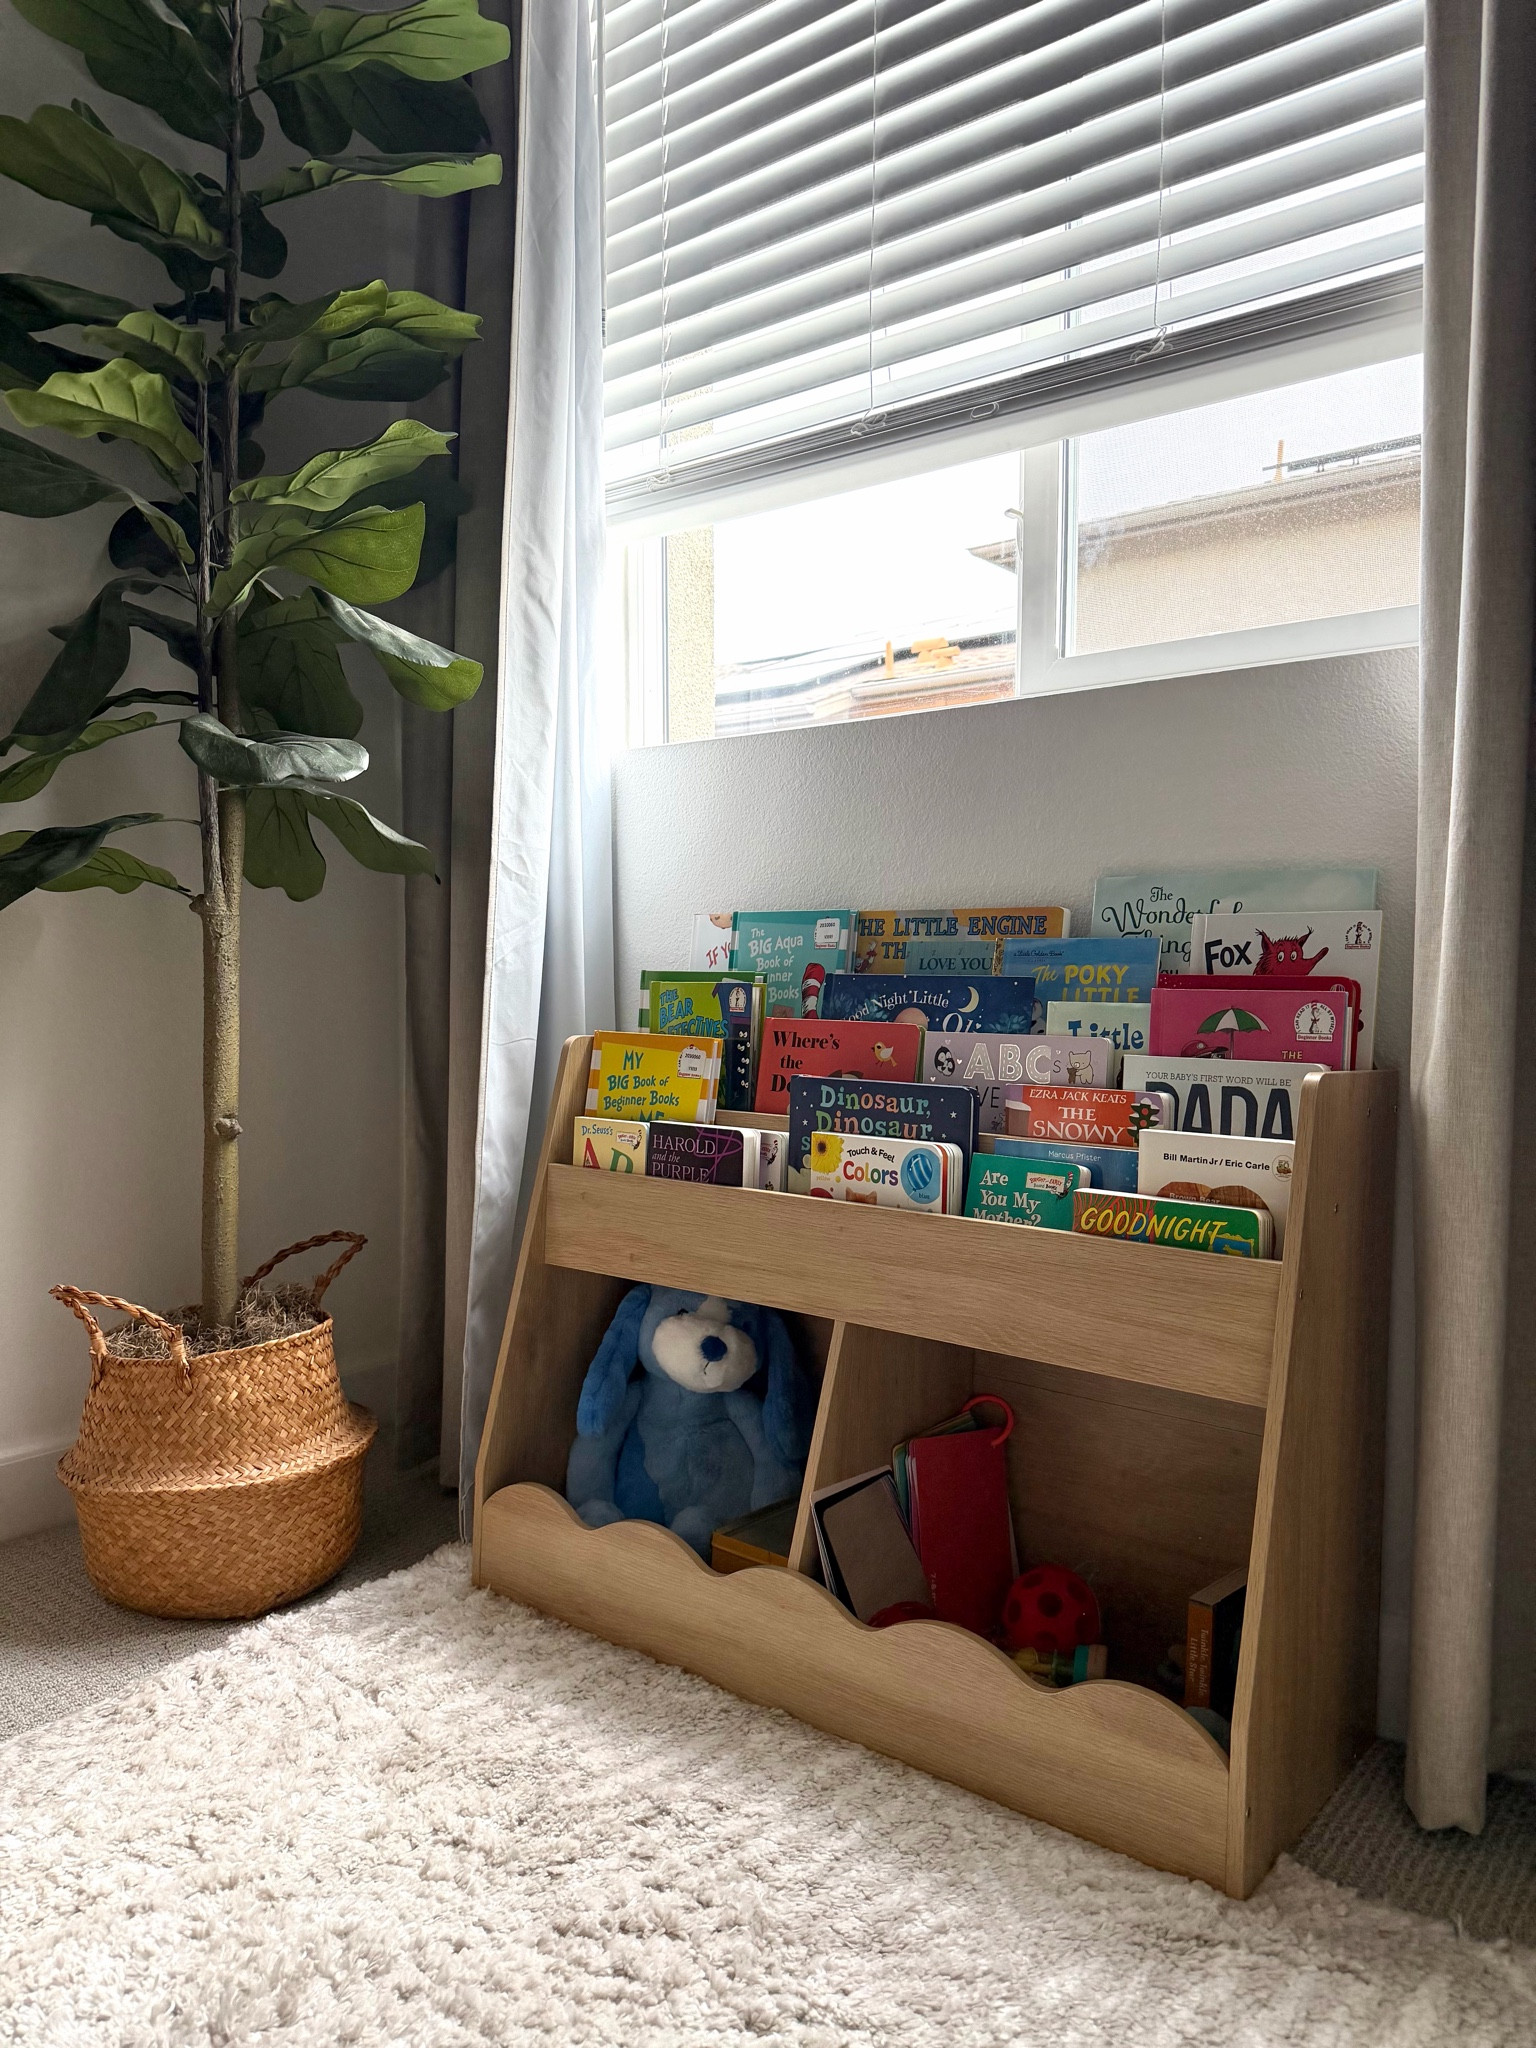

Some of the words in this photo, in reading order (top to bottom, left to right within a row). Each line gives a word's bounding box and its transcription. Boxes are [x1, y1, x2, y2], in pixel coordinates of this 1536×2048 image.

[1150, 886, 1173, 902] The
[751, 927, 765, 938] The
[858, 918, 885, 937] HE
[893, 916, 958, 937] LITTLE
[967, 915, 1048, 936] ENGINE
[749, 939, 773, 958] BIG
[775, 935, 803, 955] Aqua
[706, 946, 719, 968] IF
[756, 957, 781, 972] Book
[784, 955, 795, 968] of
[919, 957, 956, 971] LOVE
[959, 956, 994, 971] YOU
[1032, 963, 1059, 984] The
[1065, 964, 1130, 985] POKY
[659, 989, 679, 1006] THE
[768, 984, 800, 1004] Books
[871, 991, 907, 1010] Night
[911, 990, 950, 1008] Little
[659, 999, 693, 1029] BEAR
[659, 1016, 729, 1039] ETECTIVES
[772, 1031, 841, 1050] Where's
[622, 1050, 644, 1071] MY
[780, 1055, 804, 1070] the
[1281, 1050, 1303, 1060] THE
[607, 1074, 629, 1092] BIG
[632, 1075, 656, 1090] Book
[659, 1076, 670, 1087] of
[1146, 1071, 1169, 1080] YOUR
[1170, 1073, 1199, 1083] BABY'S
[1200, 1074, 1224, 1083] FIRST
[1225, 1075, 1254, 1085] WORD
[1255, 1077, 1278, 1086] WILL
[1279, 1079, 1292, 1087] BE
[603, 1095, 647, 1112] Beginner
[649, 1089, 680, 1106] Books
[820, 1084, 932, 1118] Dinosaur,
[1029, 1088, 1058, 1099] EZRA
[1060, 1090, 1089, 1102] JACK
[1092, 1092, 1128, 1104] KEATS
[1057, 1106, 1097, 1121] THE
[581, 1125, 592, 1136] Dr.
[592, 1123, 613, 1136] Seuss's
[1032, 1120, 1125, 1144] SNOWY
[652, 1134, 717, 1155] HAROLD
[651, 1150, 670, 1161] and
[672, 1151, 681, 1163] the
[846, 1146, 871, 1158] Touch
[871, 1146, 879, 1155] &
[878, 1149, 896, 1163] Feel
[1048, 1150, 1075, 1160] Marcus
[1076, 1151, 1102, 1162] Pfister
[1163, 1153, 1178, 1162] Bill
[1179, 1154, 1208, 1165] Martin
[1209, 1157, 1219, 1167] Jr
[1225, 1159, 1244, 1168] Eric
[1245, 1161, 1271, 1171] Carle
[652, 1161, 711, 1183] PURPLE
[842, 1160, 899, 1187] Colors
[979, 1169, 1009, 1186] Are
[979, 1189, 1009, 1207] You
[1012, 1191, 1041, 1215] My
[1080, 1206, 1229, 1245] GOODNIGHT
[1189, 1637, 1198, 1661] Little
